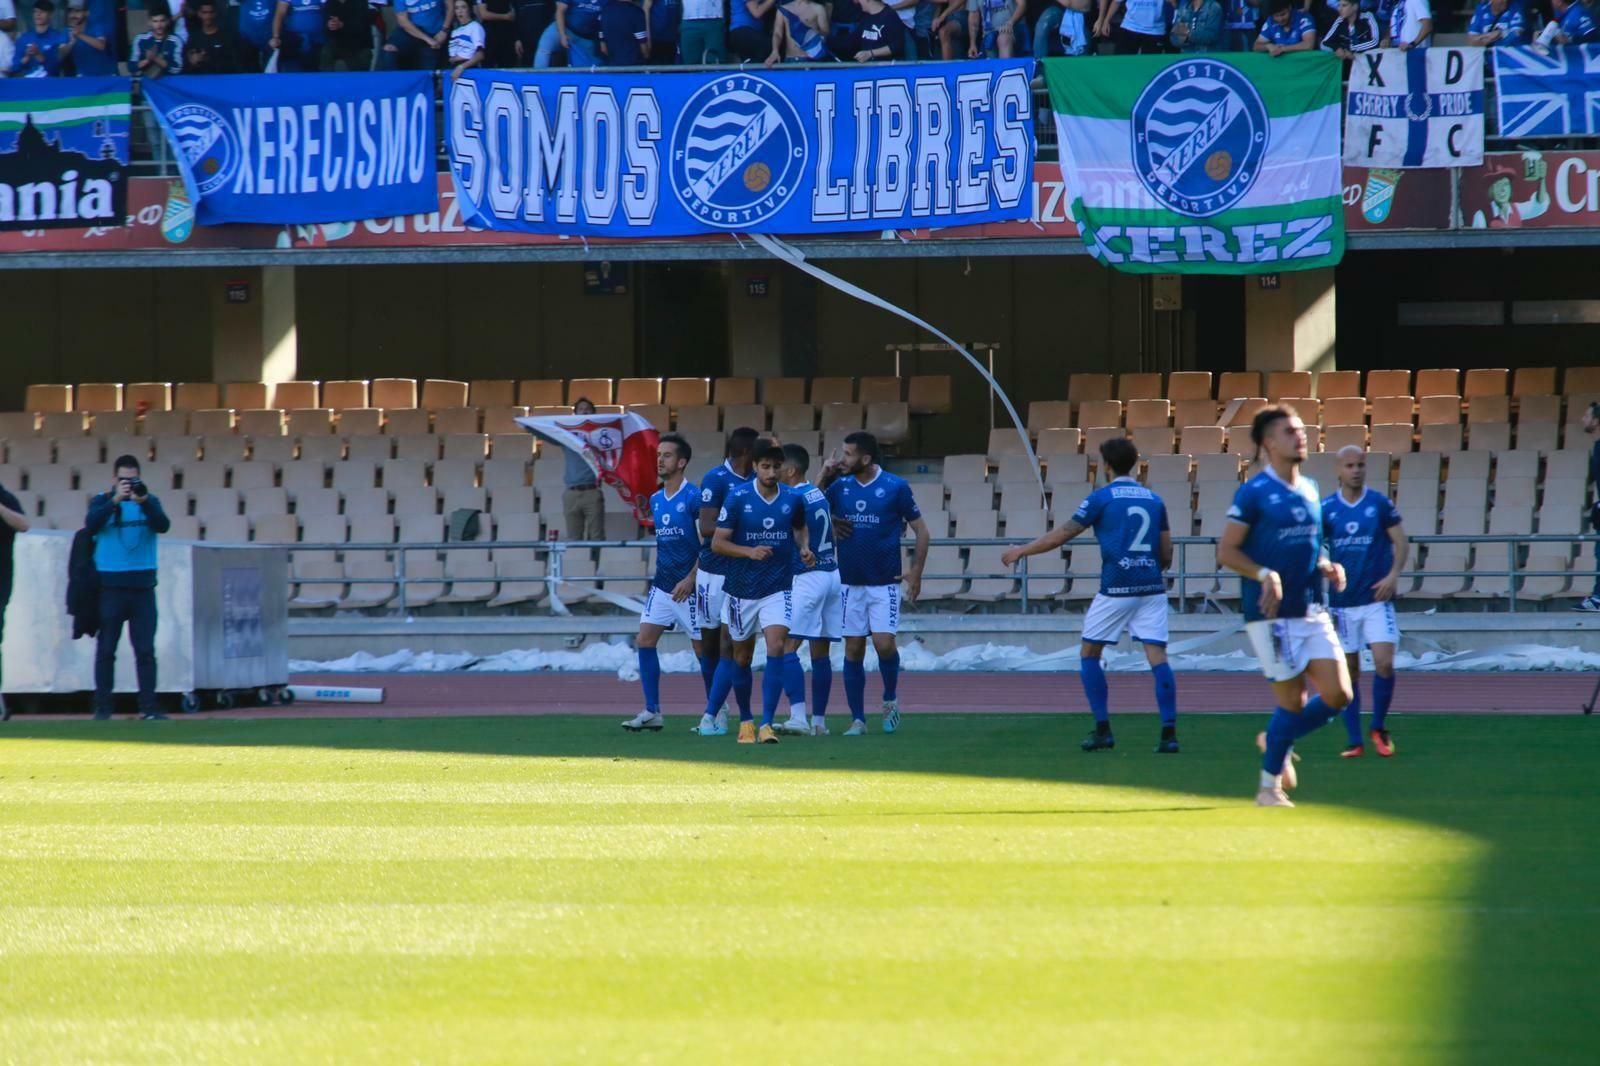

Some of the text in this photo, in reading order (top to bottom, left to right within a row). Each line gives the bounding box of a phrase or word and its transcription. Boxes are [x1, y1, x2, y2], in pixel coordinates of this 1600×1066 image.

[710, 79, 764, 97] 1911
[1172, 64, 1227, 82] 1911
[1367, 50, 1464, 88] X D
[1354, 92, 1474, 119] SHERRY PRIDE
[232, 92, 428, 195] XERECISMO
[451, 78, 662, 226] SOMOS
[704, 106, 771, 192] XEREZ
[811, 67, 1031, 223] LIBRES
[1163, 99, 1232, 183] XEREZ
[1367, 124, 1464, 159] F C
[680, 184, 788, 223] DEPORTIVO
[1146, 171, 1250, 212] DEPORTIVO
[1077, 214, 1334, 264] XEREZ
[1260, 275, 1277, 287] 114
[1126, 505, 1152, 552] 2
